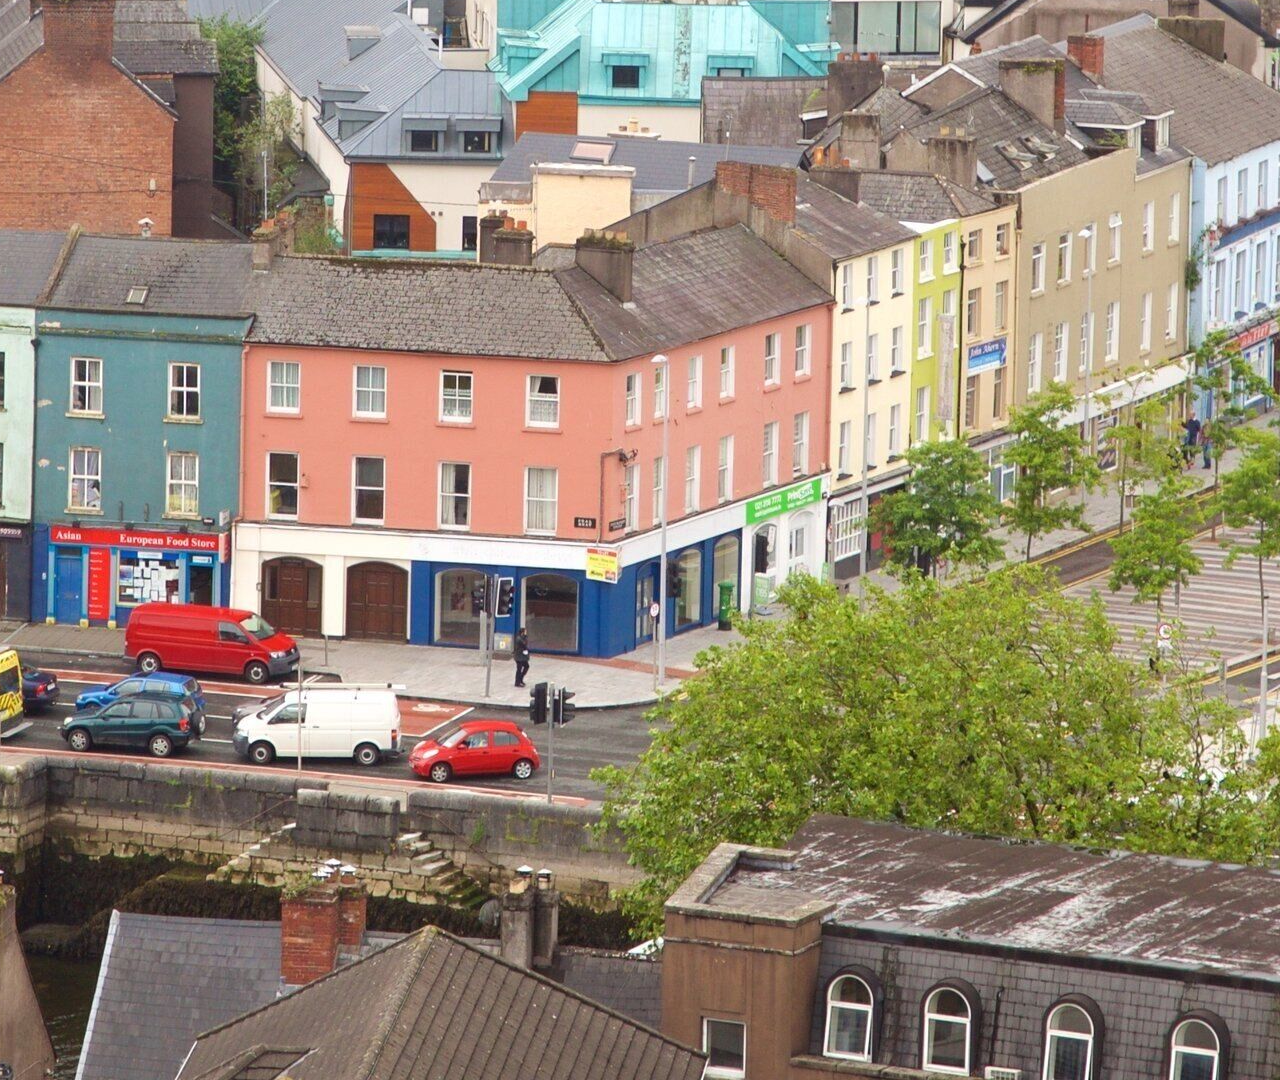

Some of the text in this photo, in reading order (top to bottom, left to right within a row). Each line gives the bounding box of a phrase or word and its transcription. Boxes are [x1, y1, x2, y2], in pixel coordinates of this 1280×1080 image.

[56, 530, 216, 549] Asian European Food Store
